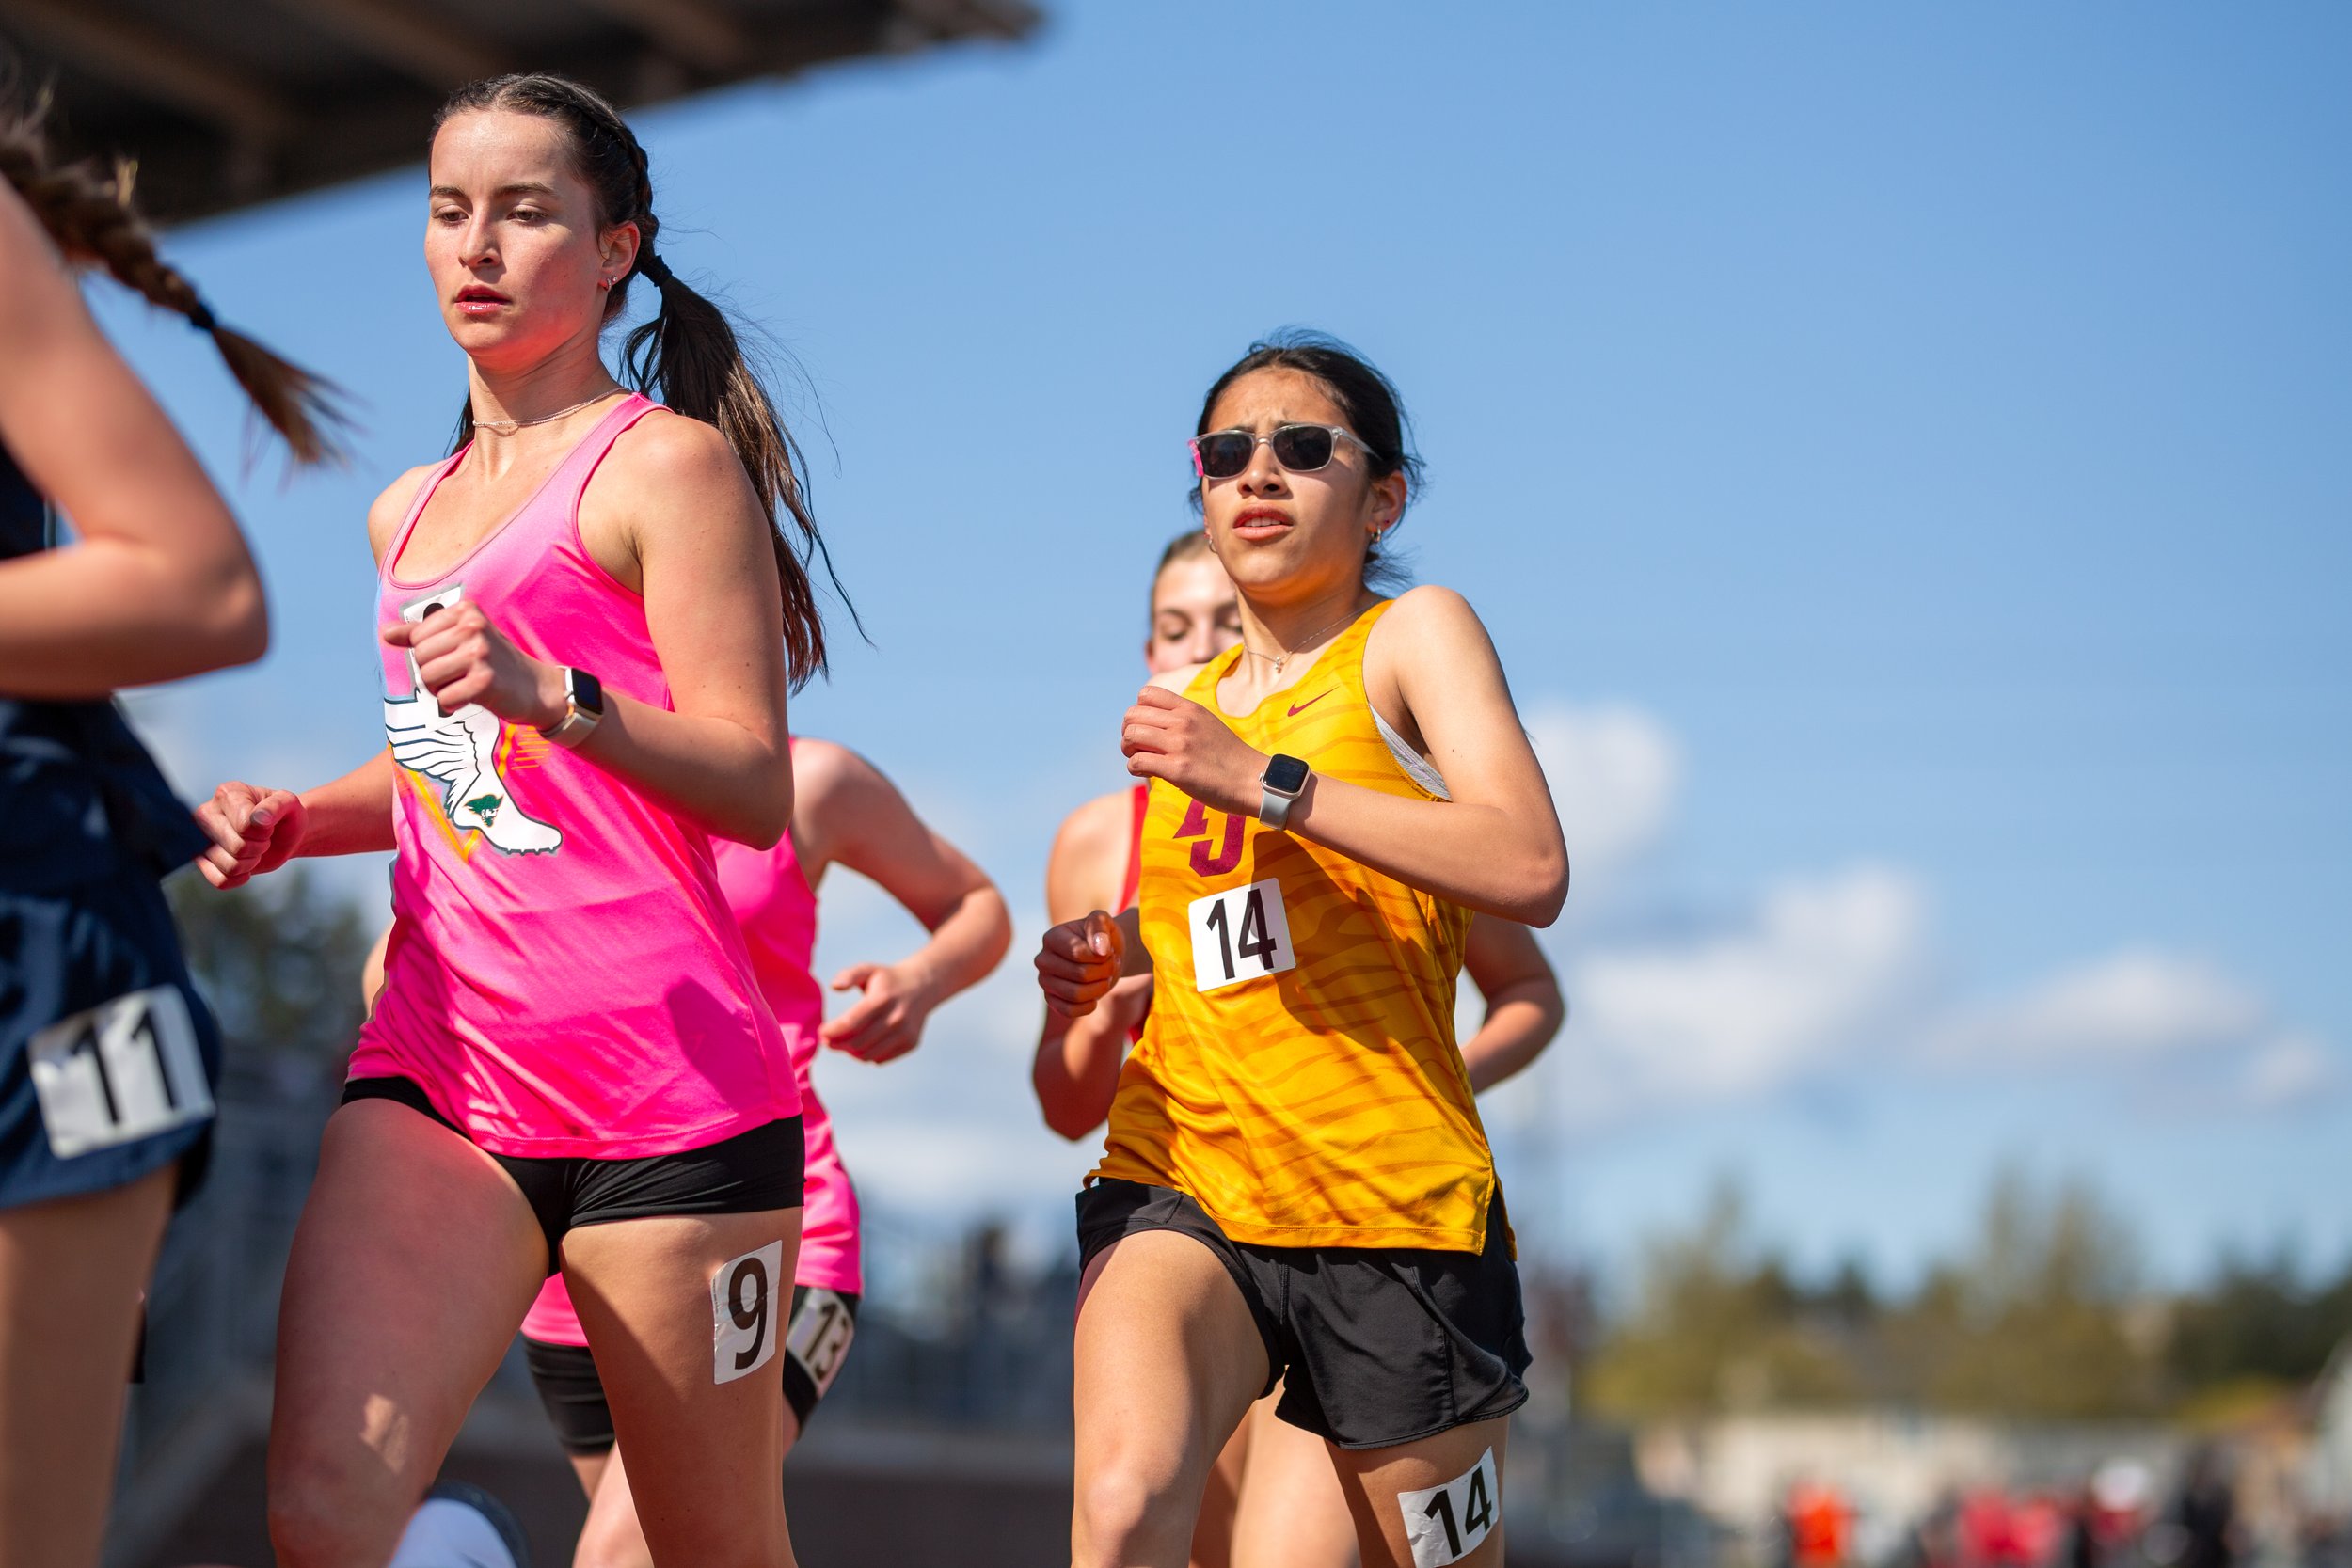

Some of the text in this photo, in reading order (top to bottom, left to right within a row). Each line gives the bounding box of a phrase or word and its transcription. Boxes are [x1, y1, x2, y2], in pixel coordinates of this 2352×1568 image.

[1205, 888, 1278, 980] 14
[69, 1006, 177, 1127] 11
[728, 1257, 768, 1370] 9
[803, 1302, 851, 1382] 13
[1423, 1465, 1493, 1559] 14
